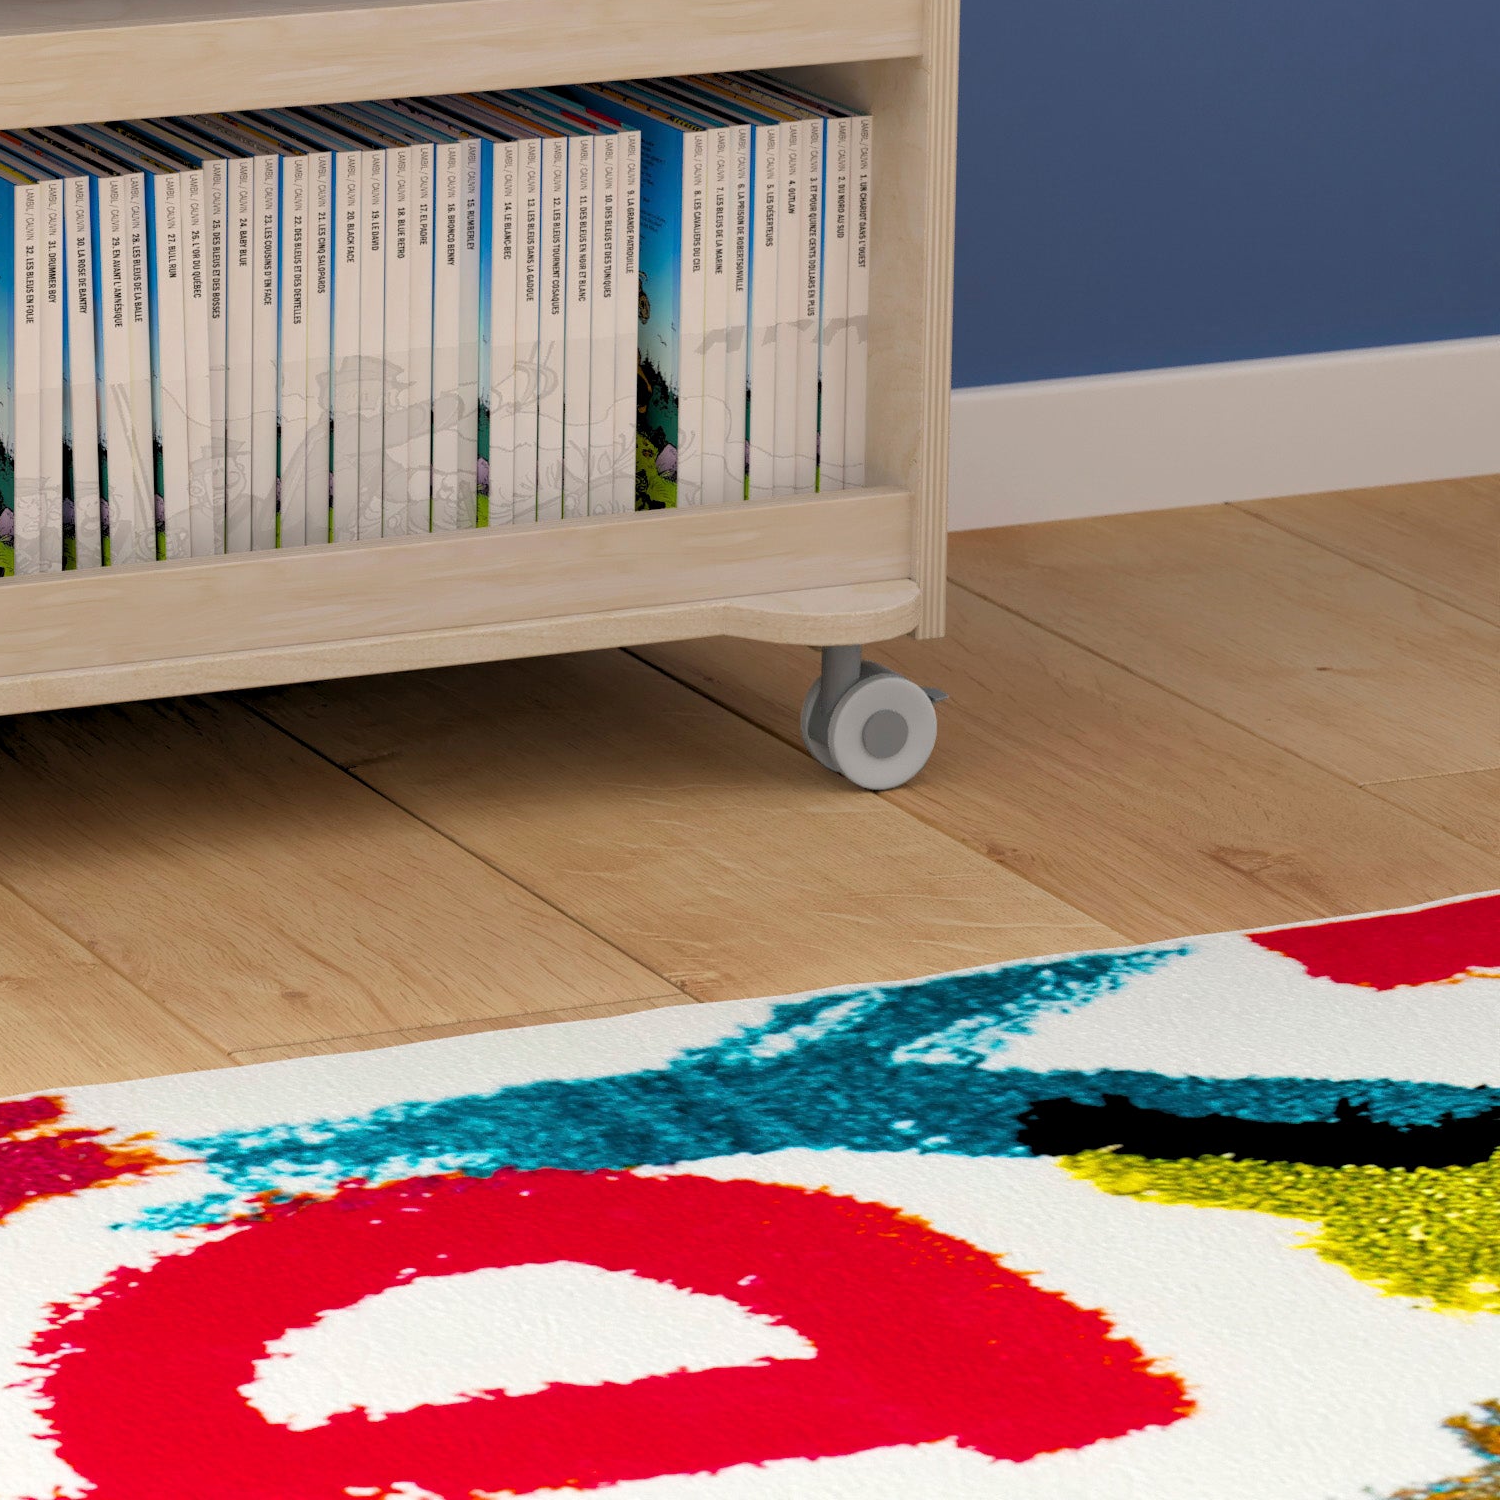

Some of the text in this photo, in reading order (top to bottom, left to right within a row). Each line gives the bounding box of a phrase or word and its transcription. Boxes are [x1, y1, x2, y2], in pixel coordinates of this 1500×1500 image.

[420, 204, 428, 213] 17.
[553, 198, 561, 208] 12.
[264, 215, 272, 225] 23.
[294, 216, 302, 227] 22.
[318, 212, 326, 222] 21.
[347, 211, 355, 222] 20.
[420, 215, 427, 223] EL
[553, 209, 561, 221] LES
[318, 224, 326, 236] LES
[447, 215, 455, 243] BRONCO
[467, 199, 475, 250] 15. RUMBERLEY
[693, 212, 701, 246] CAVALIERS
[132, 234, 140, 244] 28.
[168, 234, 176, 244] 27.
[264, 227, 272, 239] LES
[294, 228, 302, 241] DES
[347, 224, 355, 245] BLACK
[112, 237, 120, 248] 29.
[317, 238, 326, 253] CINQ
[397, 238, 405, 258] RETRO
[26, 246, 34, 256] 32.
[113, 250, 120, 258] EN
[168, 246, 176, 262] BULL
[212, 247, 220, 268] BLEUS
[264, 241, 272, 270] COUSINS
[294, 243, 302, 264] BLEUS
[447, 244, 455, 265] BENNY
[626, 236, 634, 274] PATROUILLE
[693, 248, 700, 257] DU
[26, 258, 34, 270] LES
[239, 250, 247, 266] BLUE
[113, 260, 121, 280] AVANT
[133, 260, 141, 281] BLEUS
[193, 261, 200, 269] DU
[48, 241, 56, 303] 31. DRUMMER BOY
[77, 237, 87, 313] 30. LA ROSE DE BANTRY
[26, 272, 34, 293] BLEUS
[134, 283, 142, 291] DE
[212, 278, 220, 291] DES
[294, 274, 302, 287] DES
[26, 295, 34, 303] EN
[134, 293, 142, 301] LA
[264, 289, 272, 305] FACE
[212, 293, 220, 319] BOSSES
[26, 305, 34, 323] FOLIE
